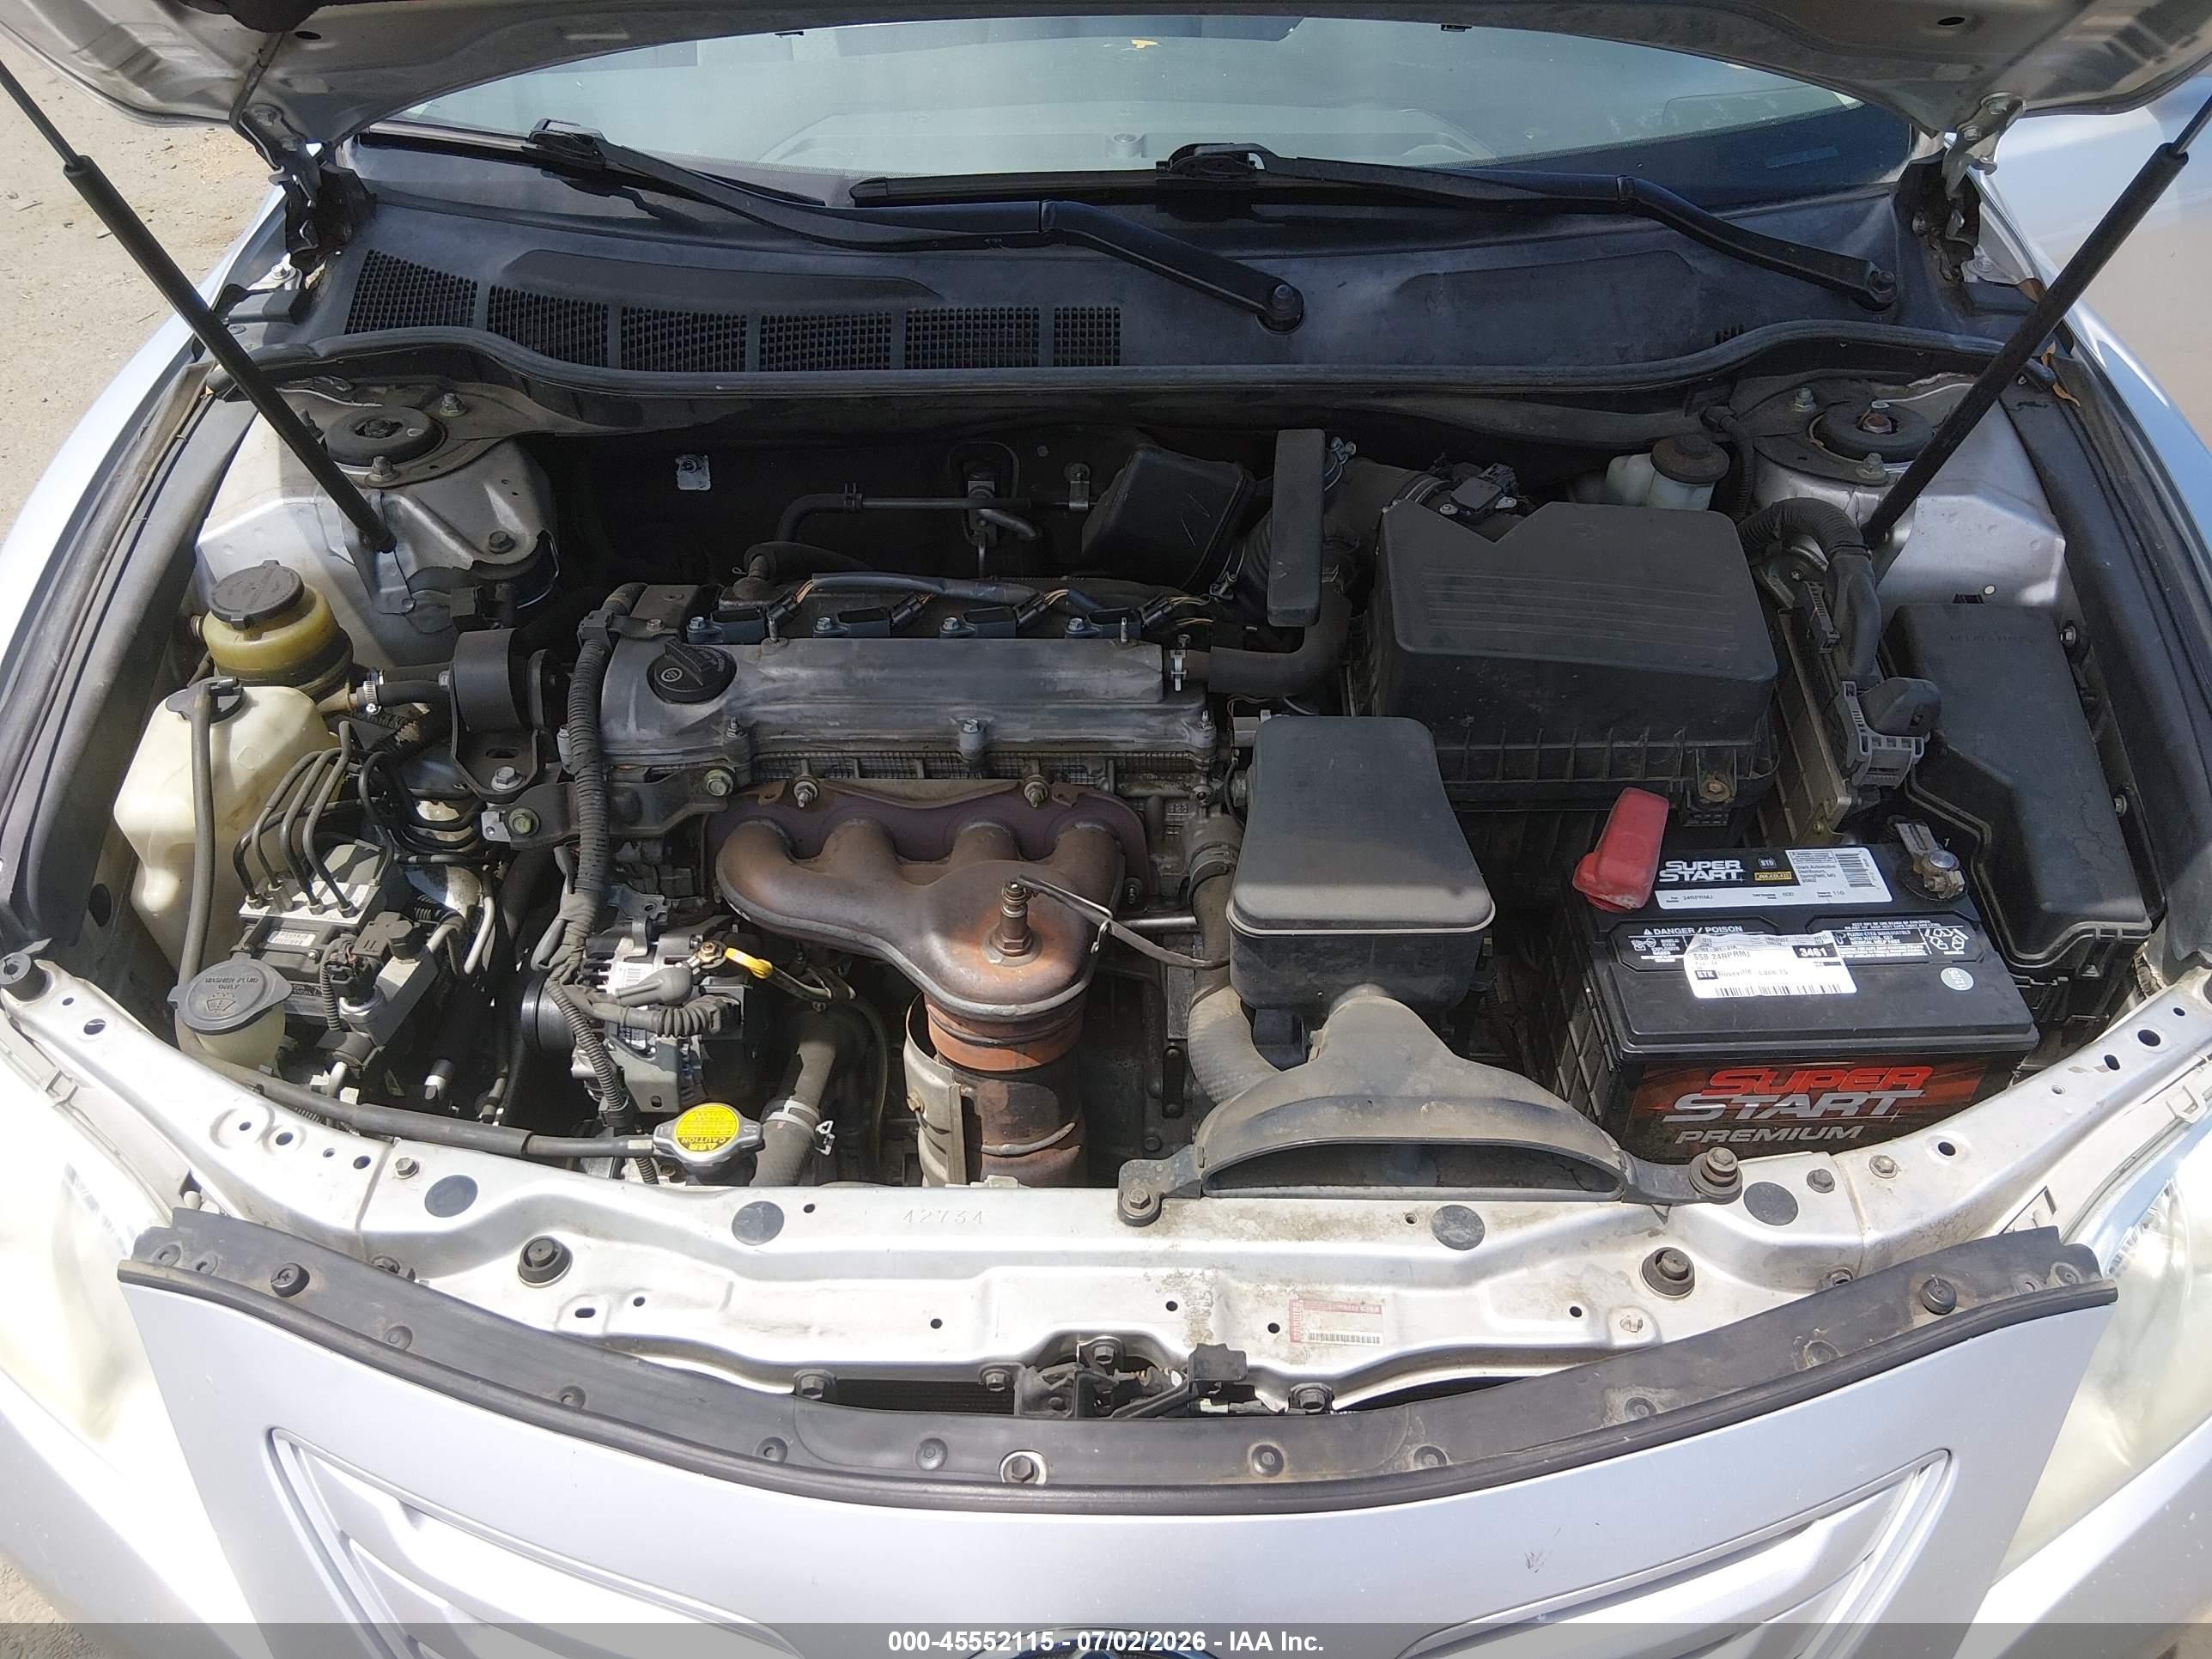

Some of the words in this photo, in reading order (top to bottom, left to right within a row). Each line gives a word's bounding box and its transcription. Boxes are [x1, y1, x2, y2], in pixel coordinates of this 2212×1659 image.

[1665, 860, 1741, 872] SUPER
[1659, 868, 1744, 883] START
[1705, 925, 1743, 933] POISON
[1798, 947, 1828, 957] 3461
[1701, 1066, 1933, 1097] SUPER
[1662, 1090, 1924, 1122] START
[1675, 1125, 1866, 1145] PREMIUM
